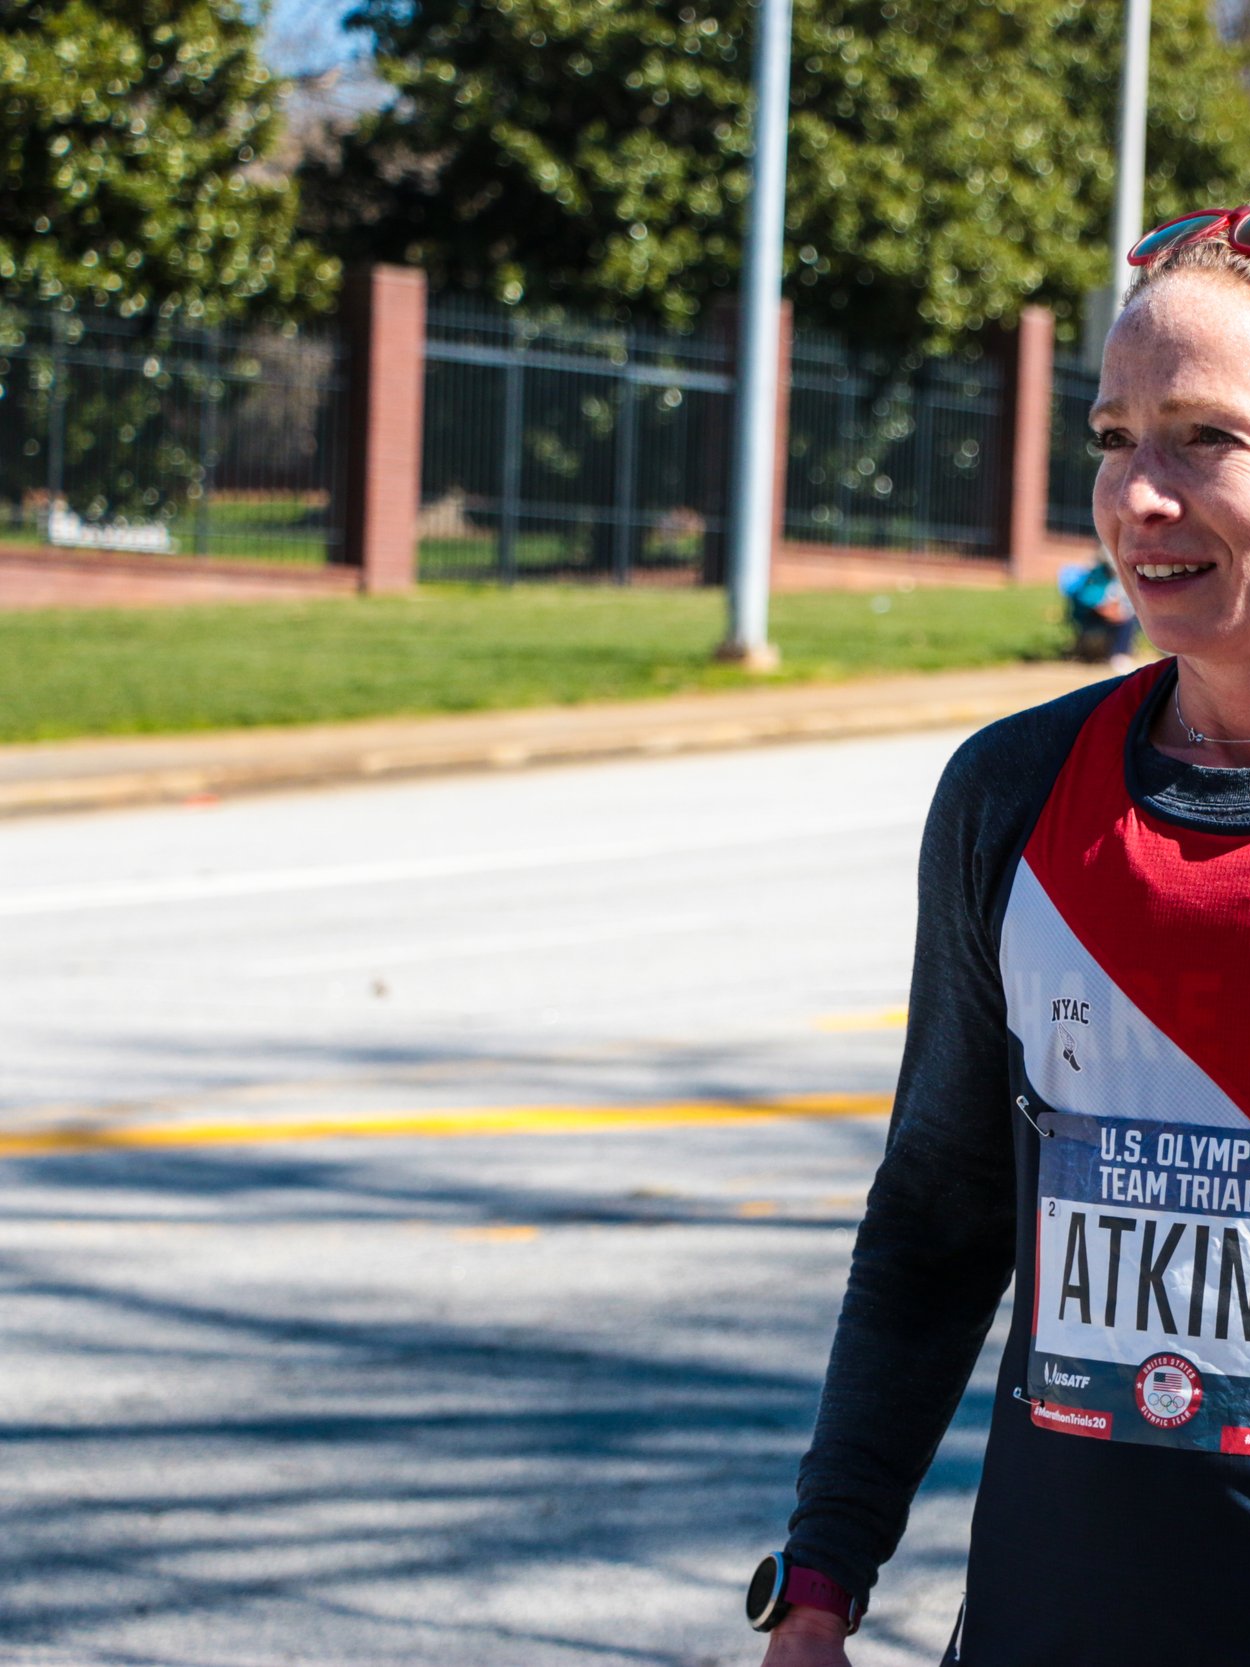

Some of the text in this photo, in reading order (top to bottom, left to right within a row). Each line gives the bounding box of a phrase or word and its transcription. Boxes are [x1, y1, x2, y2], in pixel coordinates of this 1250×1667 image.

[1051, 998, 1090, 1024] NYAC
[1101, 1127, 1147, 1164] U.S.
[1099, 1166, 1168, 1205] TEAM
[1048, 1201, 1057, 1218] 2
[1143, 1357, 1196, 1379] UNITED STATES
[1054, 1373, 1090, 1389] USATF
[1034, 1406, 1106, 1429] #MarathonTrials20
[1141, 1405, 1192, 1427] OLYMPIC TEAM
